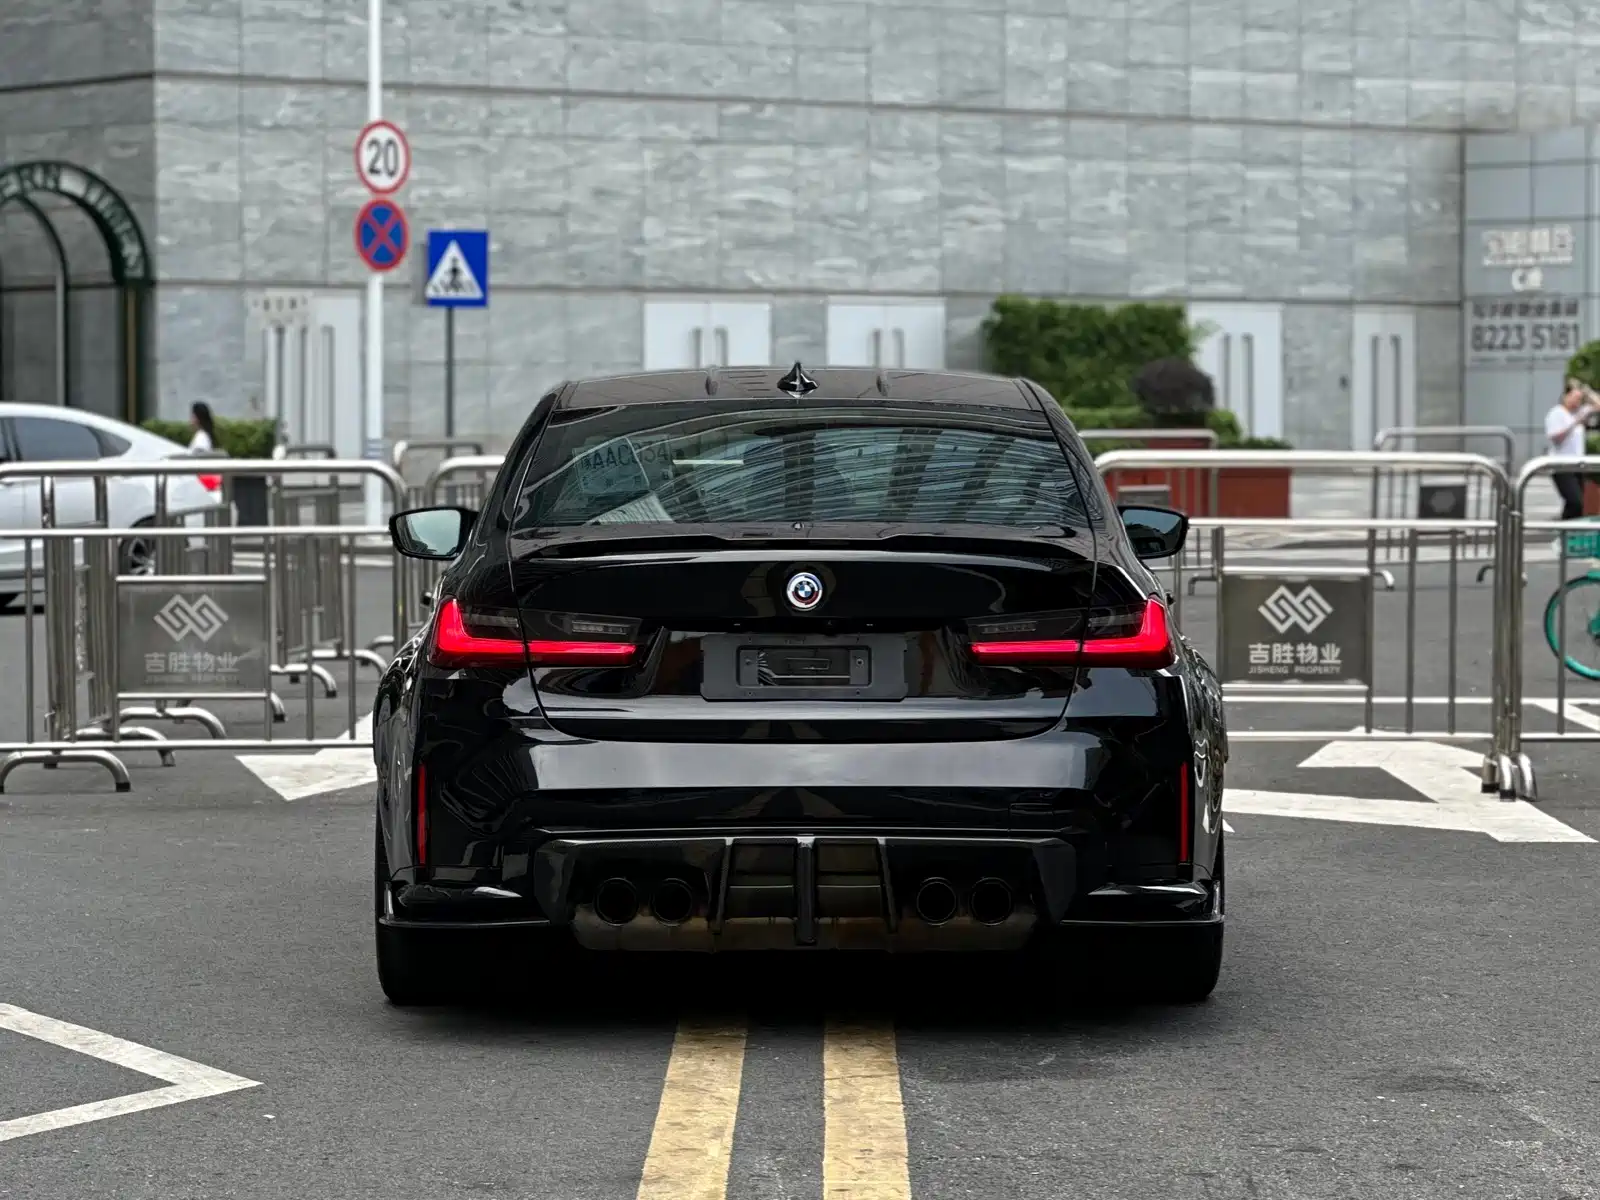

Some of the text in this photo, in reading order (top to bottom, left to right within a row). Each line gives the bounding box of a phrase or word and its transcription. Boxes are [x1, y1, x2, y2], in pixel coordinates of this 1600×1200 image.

[367, 137, 399, 179] 20
[144, 652, 240, 673] 吉胜物业
[1248, 642, 1342, 664] 吉胜物业
[1248, 665, 1341, 674] JISHENG PROPERTY
